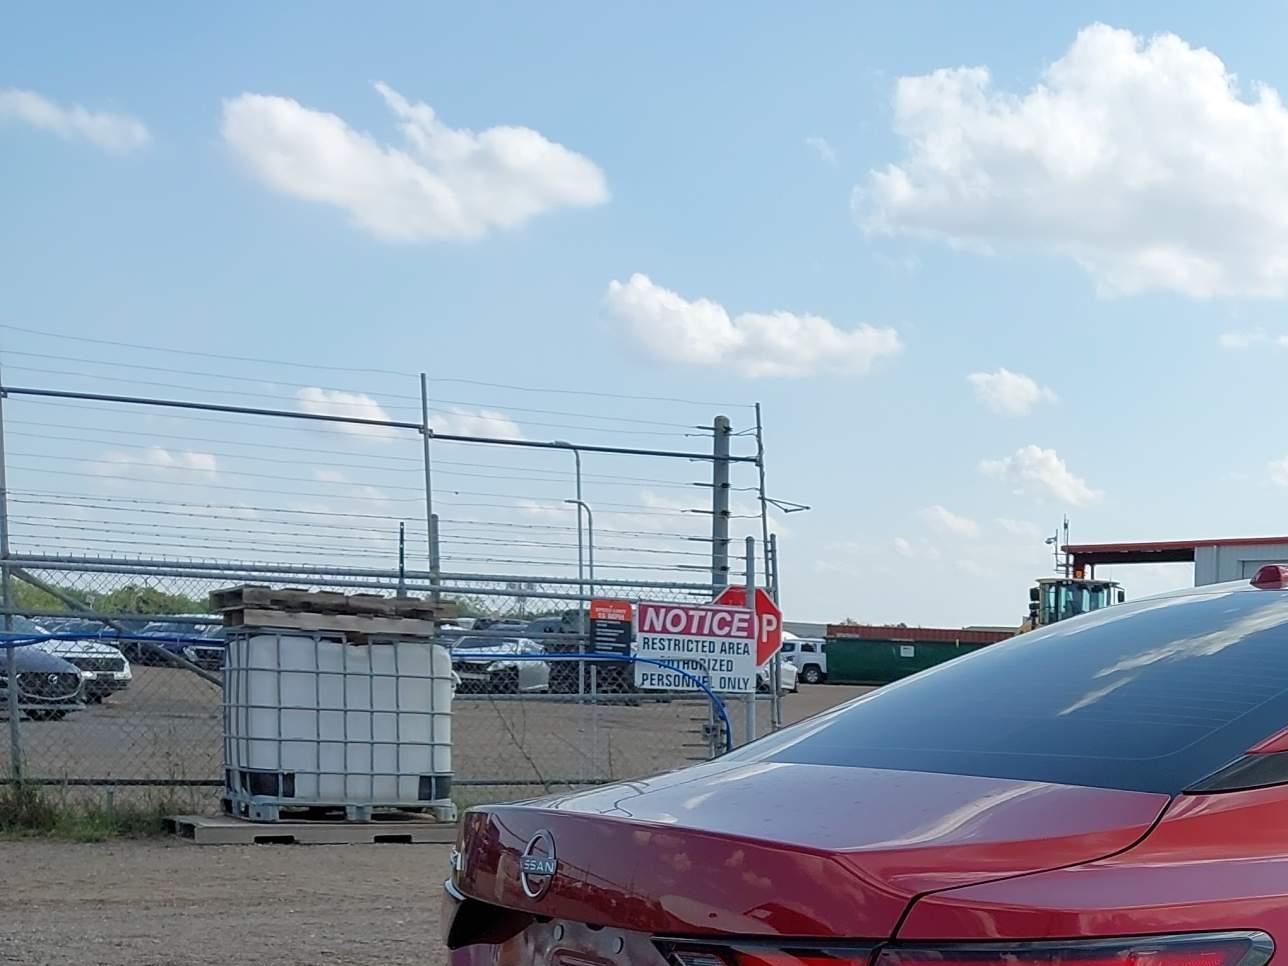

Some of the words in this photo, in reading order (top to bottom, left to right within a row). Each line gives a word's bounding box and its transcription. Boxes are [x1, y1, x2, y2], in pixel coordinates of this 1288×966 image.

[643, 608, 749, 637] NOTICE
[642, 637, 716, 654] RESTRICTED
[719, 642, 750, 656] AREA
[719, 676, 750, 690] ONLY
[521, 858, 554, 873] SSAN
